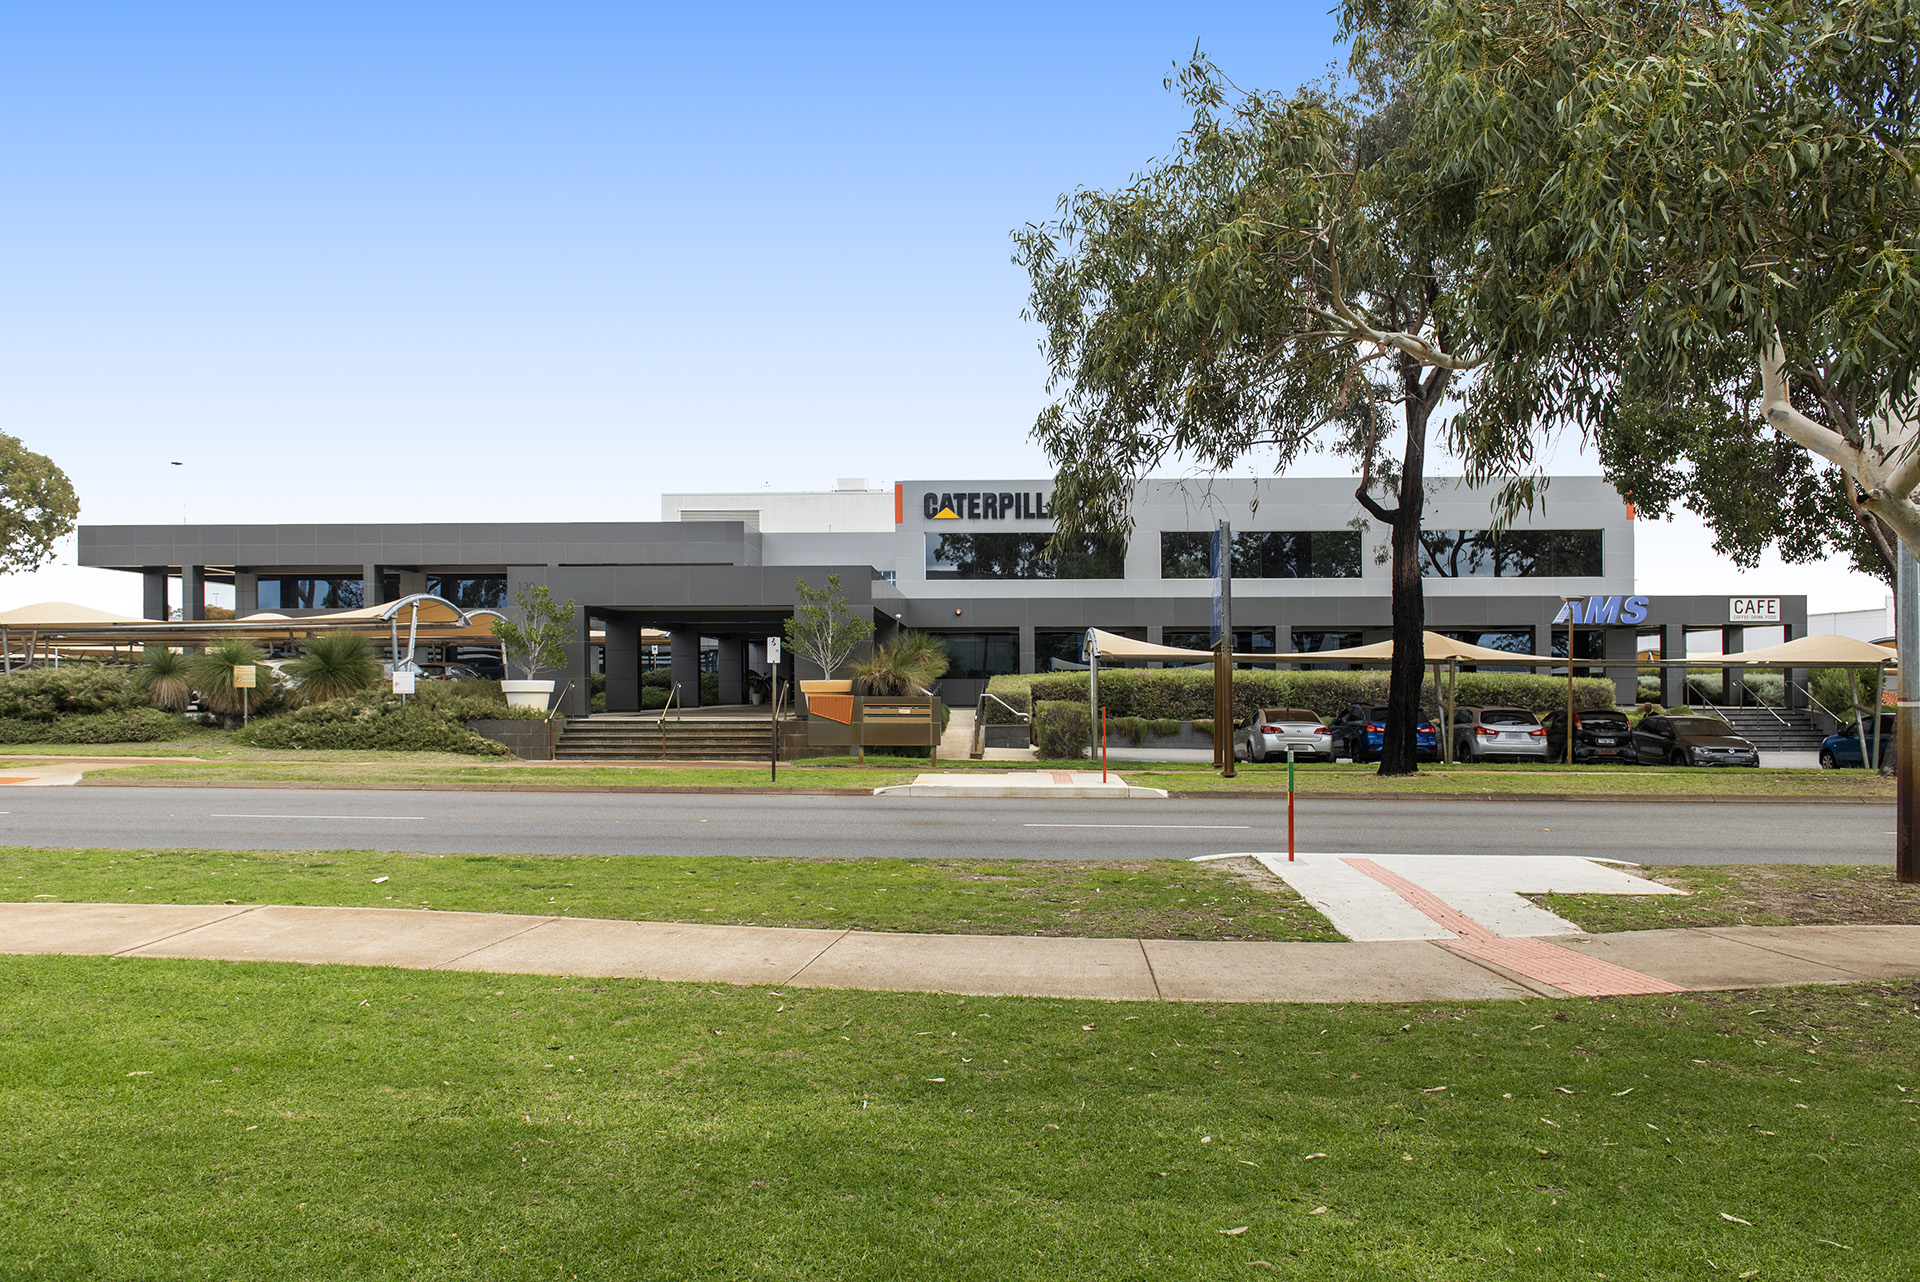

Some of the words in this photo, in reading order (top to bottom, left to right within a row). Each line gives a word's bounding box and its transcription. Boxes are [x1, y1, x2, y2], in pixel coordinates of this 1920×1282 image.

[923, 492, 1054, 520] CATERPILL
[1552, 596, 1650, 624] AMS
[1734, 600, 1776, 614] CAFE
